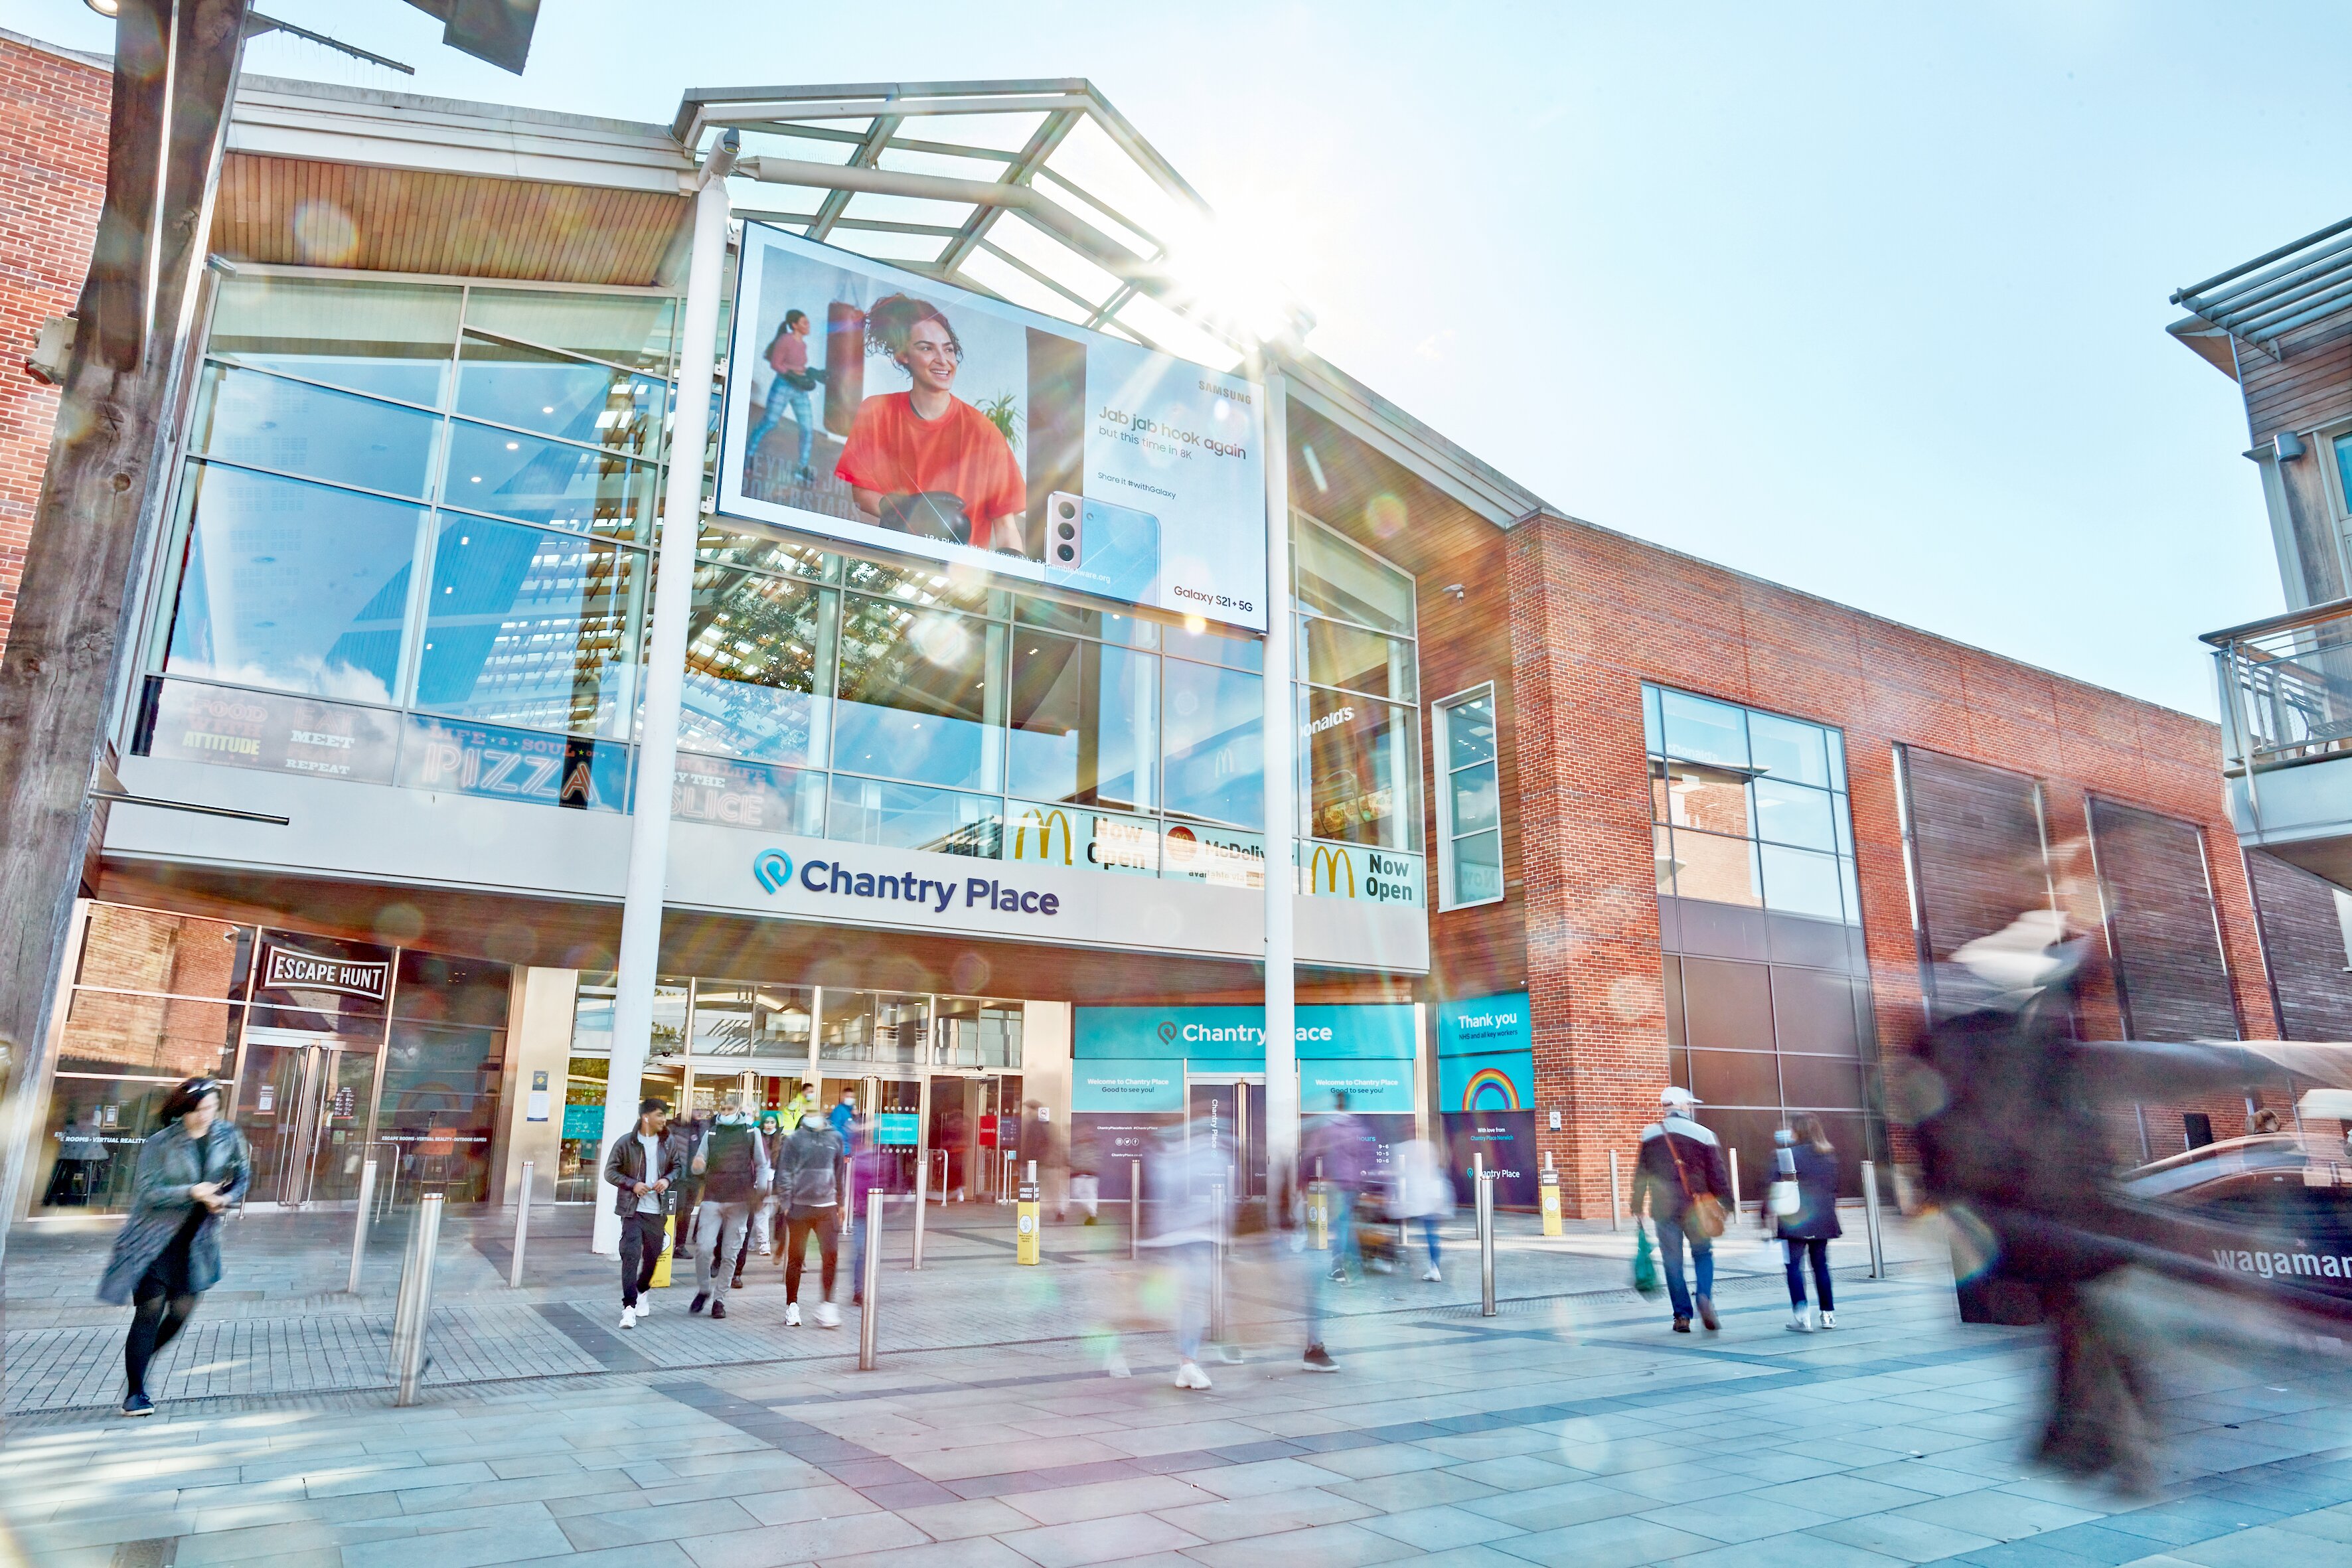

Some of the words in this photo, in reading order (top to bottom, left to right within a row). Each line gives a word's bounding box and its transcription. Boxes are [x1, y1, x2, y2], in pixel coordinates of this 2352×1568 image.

[1199, 380, 1251, 404] SAMSUNG
[1099, 406, 1129, 425] Jab
[1131, 414, 1157, 433] jab
[1162, 423, 1200, 446] hook
[1204, 437, 1246, 459] again
[1099, 426, 1117, 439] but
[1121, 431, 1139, 445] this
[1142, 437, 1166, 452] time
[1169, 445, 1178, 456] in
[1180, 449, 1192, 459] 8K
[1098, 472, 1120, 483] Share
[1128, 479, 1176, 499] #withGalaxy
[1174, 586, 1214, 605] Galaxy
[1239, 601, 1253, 612] 5G
[191, 699, 268, 723] FOOD
[293, 706, 360, 736] EAT
[187, 715, 264, 738] WITH
[182, 731, 261, 755] ATTITUDE
[290, 730, 355, 749] MEET
[430, 726, 486, 745] LIFE
[499, 736, 509, 745] &
[522, 738, 576, 758] SOUL
[285, 759, 350, 775] REPEAT
[422, 743, 602, 803] PIZZA
[690, 773, 726, 788] THE
[1093, 817, 1143, 844] Now
[1087, 842, 1146, 870] Open
[1370, 854, 1409, 877] Now
[801, 860, 957, 913] Chantry
[967, 878, 1059, 915] Place
[1366, 877, 1412, 902] Open
[274, 955, 337, 982] ESCAPE
[339, 967, 382, 990] HUNT
[1458, 1012, 1493, 1029] Thank
[1495, 1013, 1517, 1029] you
[1182, 1024, 1265, 1046] Chantry
[1295, 1027, 1332, 1041] ace
[1502, 1170, 1520, 1178] Place
